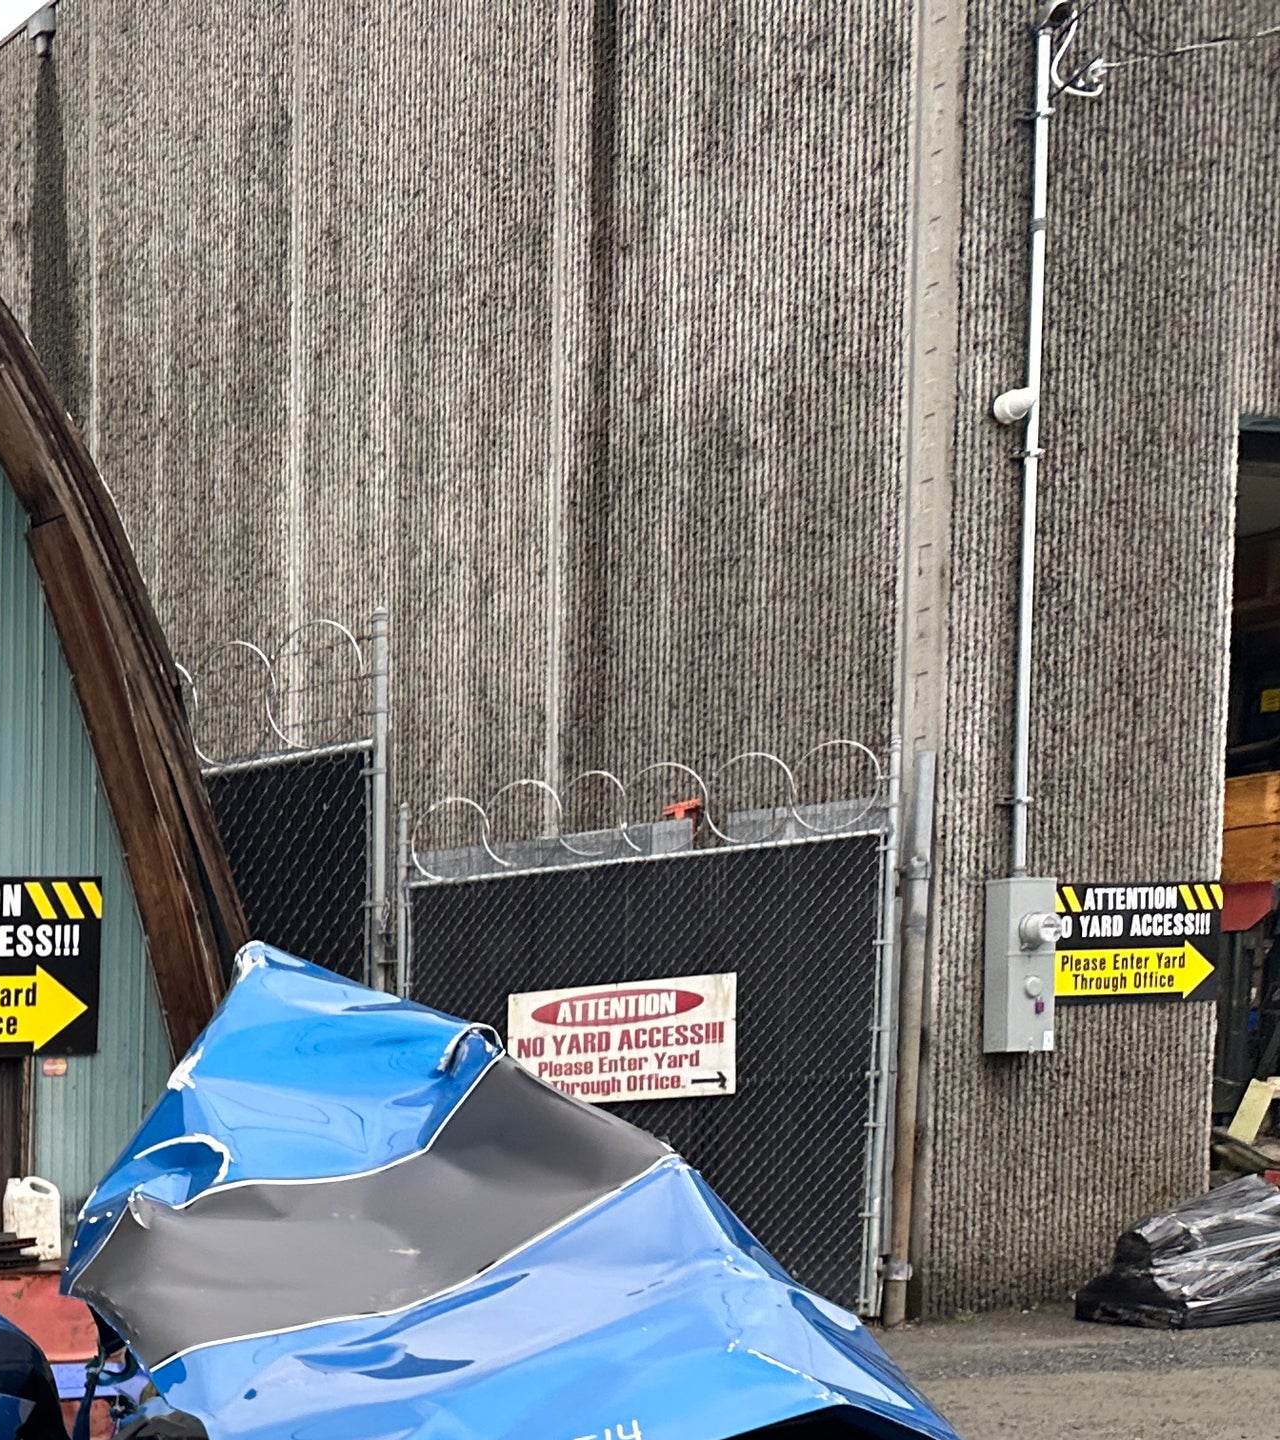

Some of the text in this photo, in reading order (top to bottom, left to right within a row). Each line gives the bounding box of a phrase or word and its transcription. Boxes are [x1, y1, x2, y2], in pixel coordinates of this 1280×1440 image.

[1083, 886, 1178, 911] ATTENTION
[1080, 913, 1124, 938] YARD
[1130, 912, 1211, 937] ACCESS!!!
[1061, 952, 1186, 972] Please Enter Yard
[1072, 972, 1175, 992] Through Office
[556, 991, 677, 1024] ATTENTION
[517, 1021, 725, 1059] NO YARD ACCESS!!!
[538, 1050, 700, 1079] Please Enter Yard
